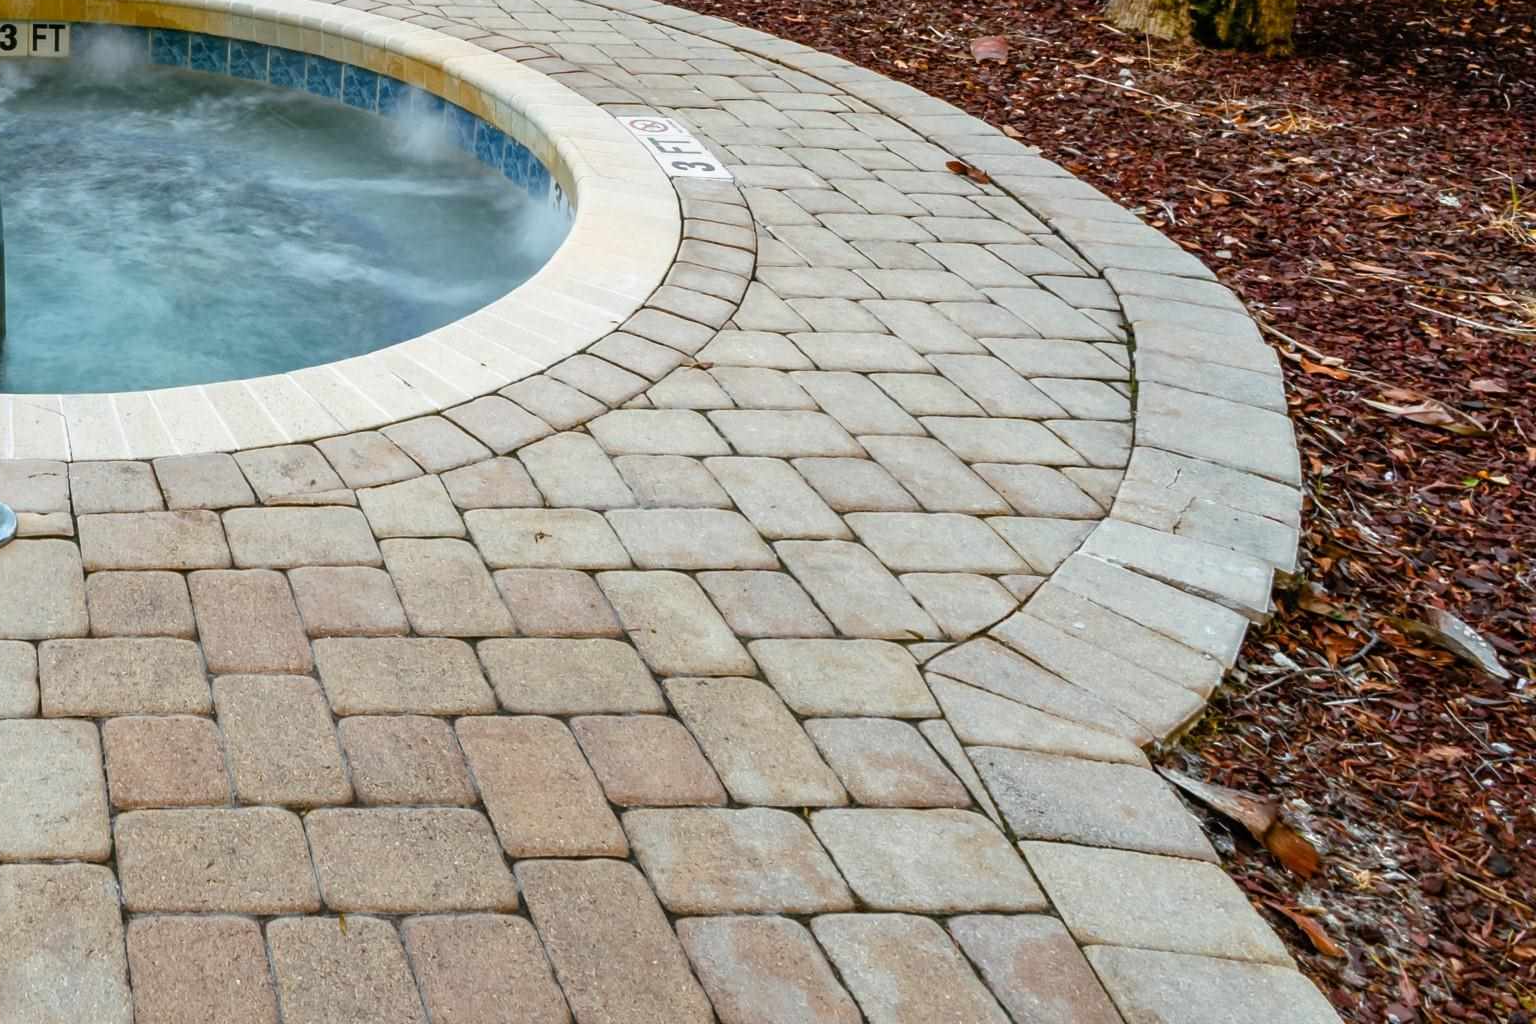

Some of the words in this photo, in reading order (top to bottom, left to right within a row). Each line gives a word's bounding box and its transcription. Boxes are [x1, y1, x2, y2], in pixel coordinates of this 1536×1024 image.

[0, 23, 18, 52] 3
[32, 23, 66, 52] FT
[647, 137, 703, 154] FT
[671, 161, 716, 172] 3
